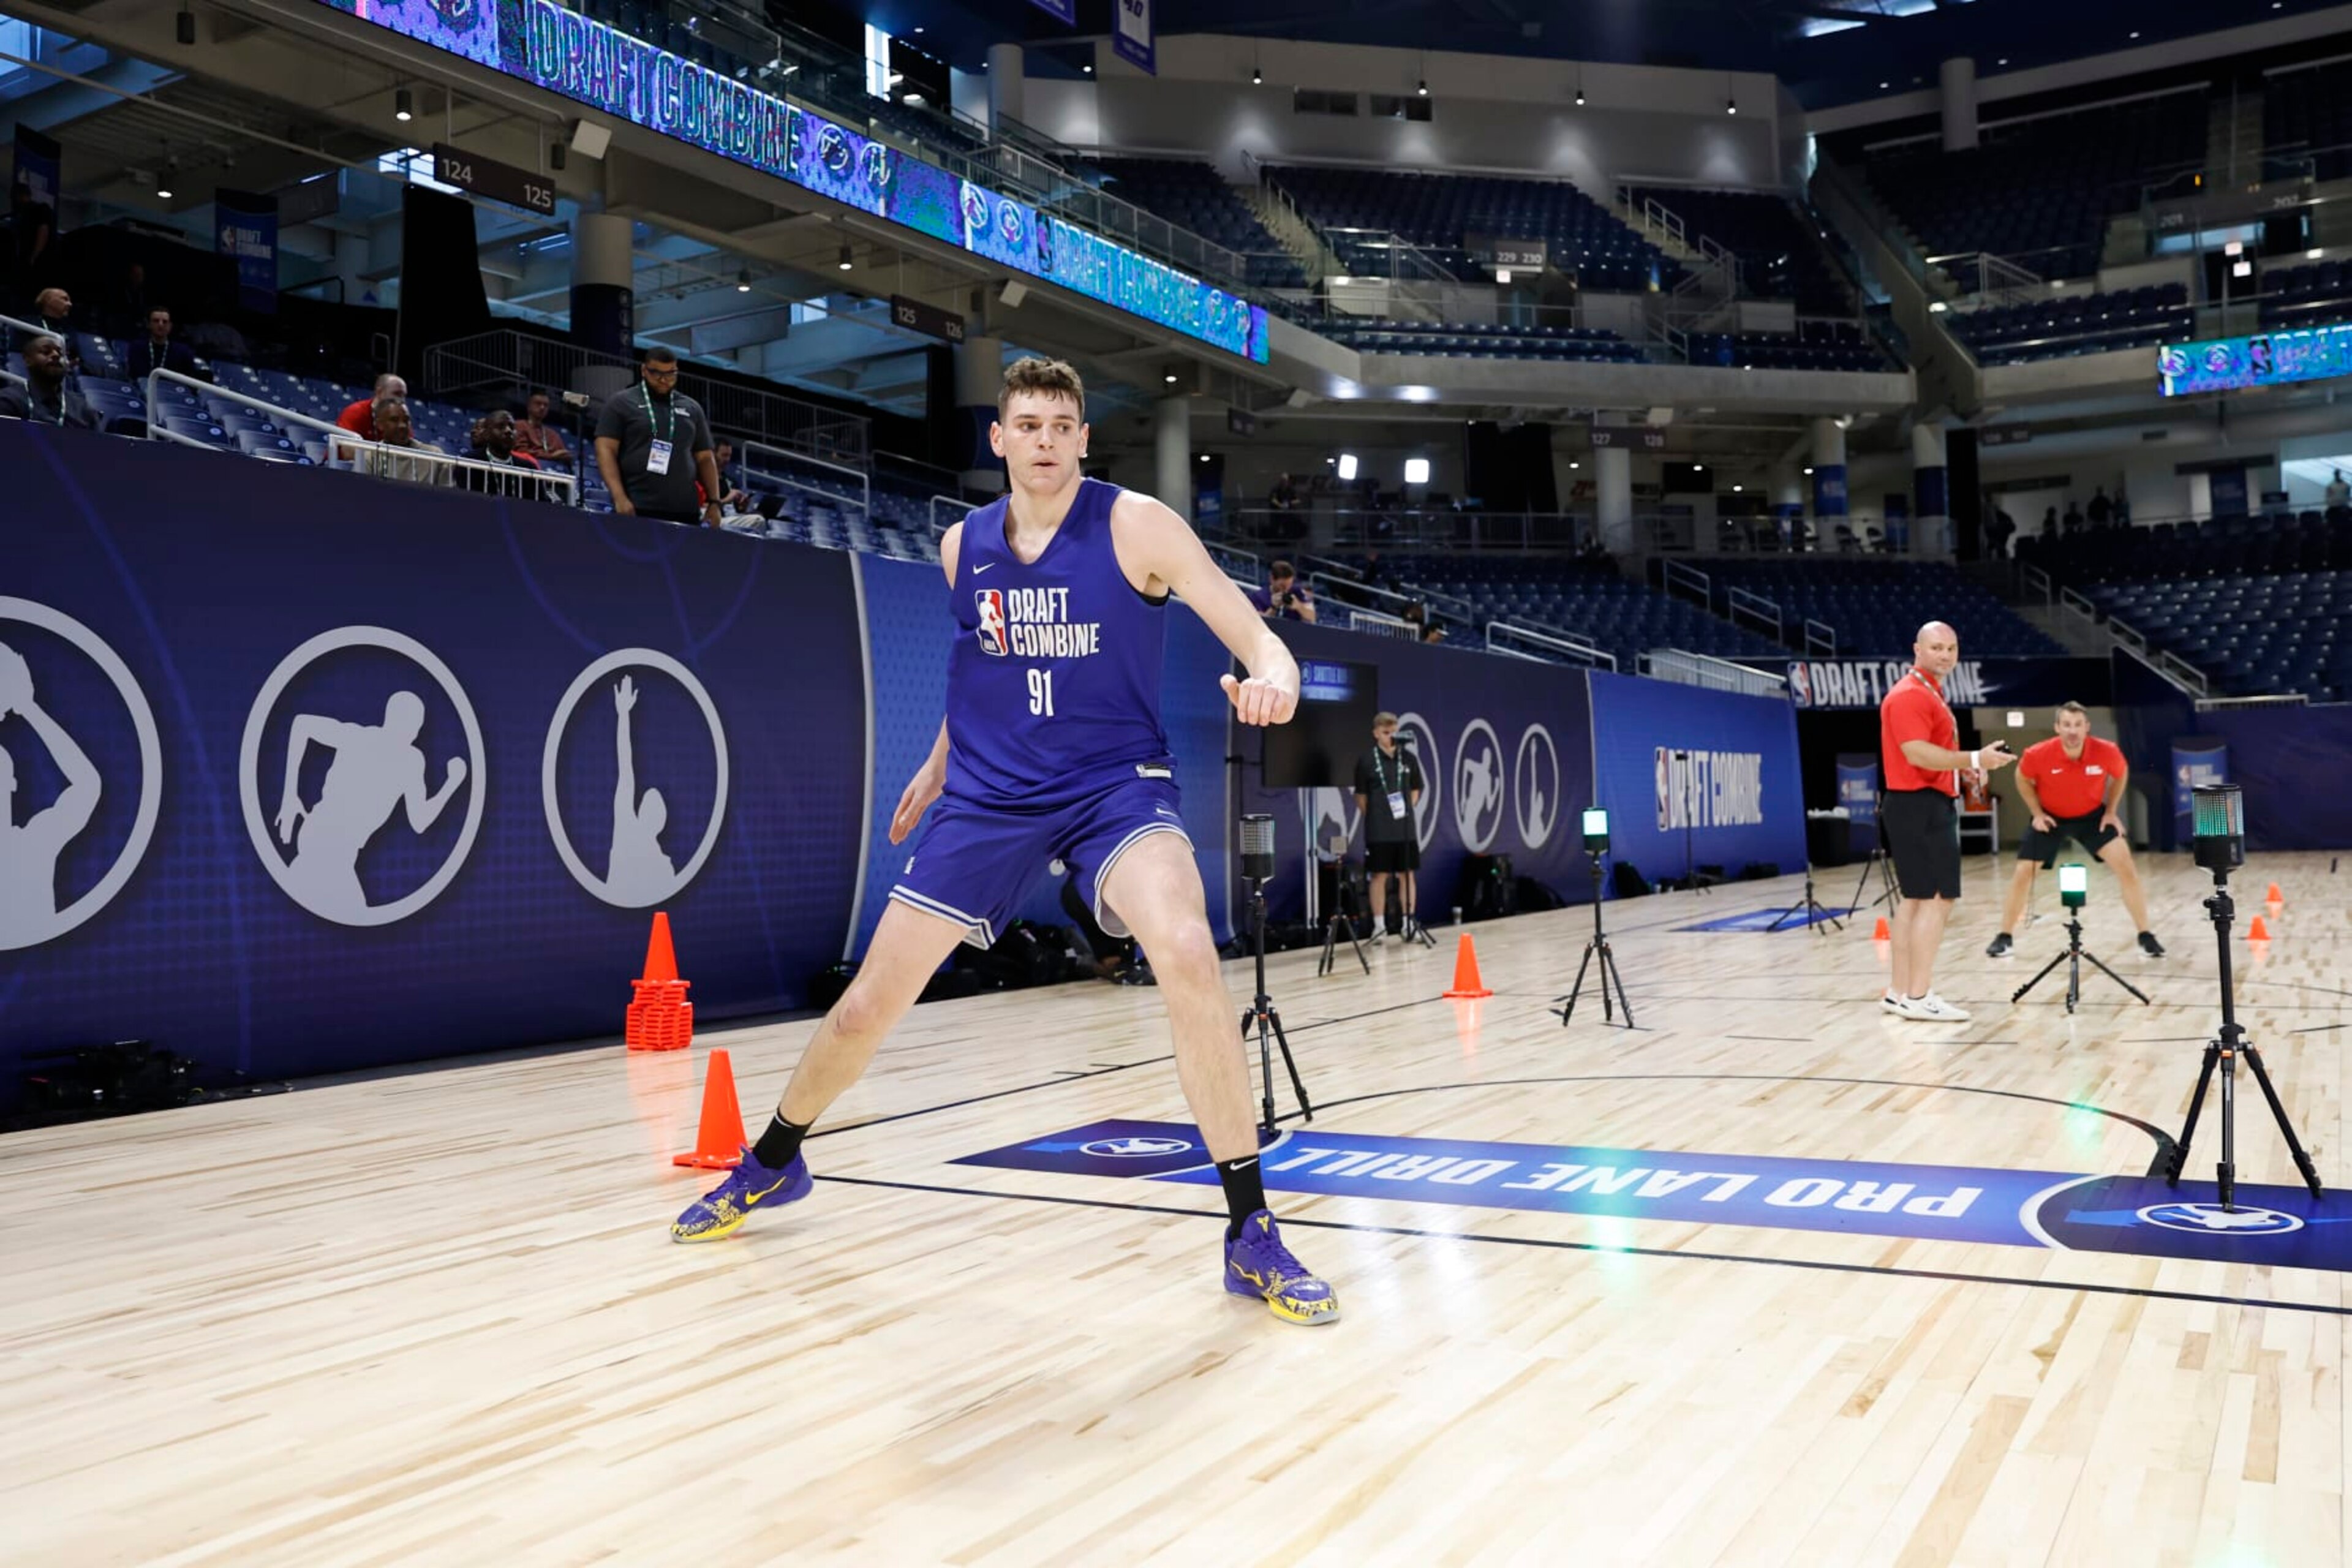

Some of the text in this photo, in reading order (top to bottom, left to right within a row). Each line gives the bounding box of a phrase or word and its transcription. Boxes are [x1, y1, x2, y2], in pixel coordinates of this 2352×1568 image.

[533, 0, 804, 178] DRAFT COMBINE
[442, 158, 552, 208] 124 125
[1497, 252, 1517, 262] 229
[1521, 253, 1543, 263] 230
[898, 307, 916, 324] 125
[1591, 433, 1611, 445] 127
[1008, 587, 1069, 624] DRAFT
[1011, 623, 1100, 658] COMBINE
[1027, 668, 1054, 717] 91
[1810, 662, 1880, 706] DRAFT
[1668, 748, 1709, 828] DRAFT
[1265, 1147, 1984, 1218] PRO LANE DRILL
